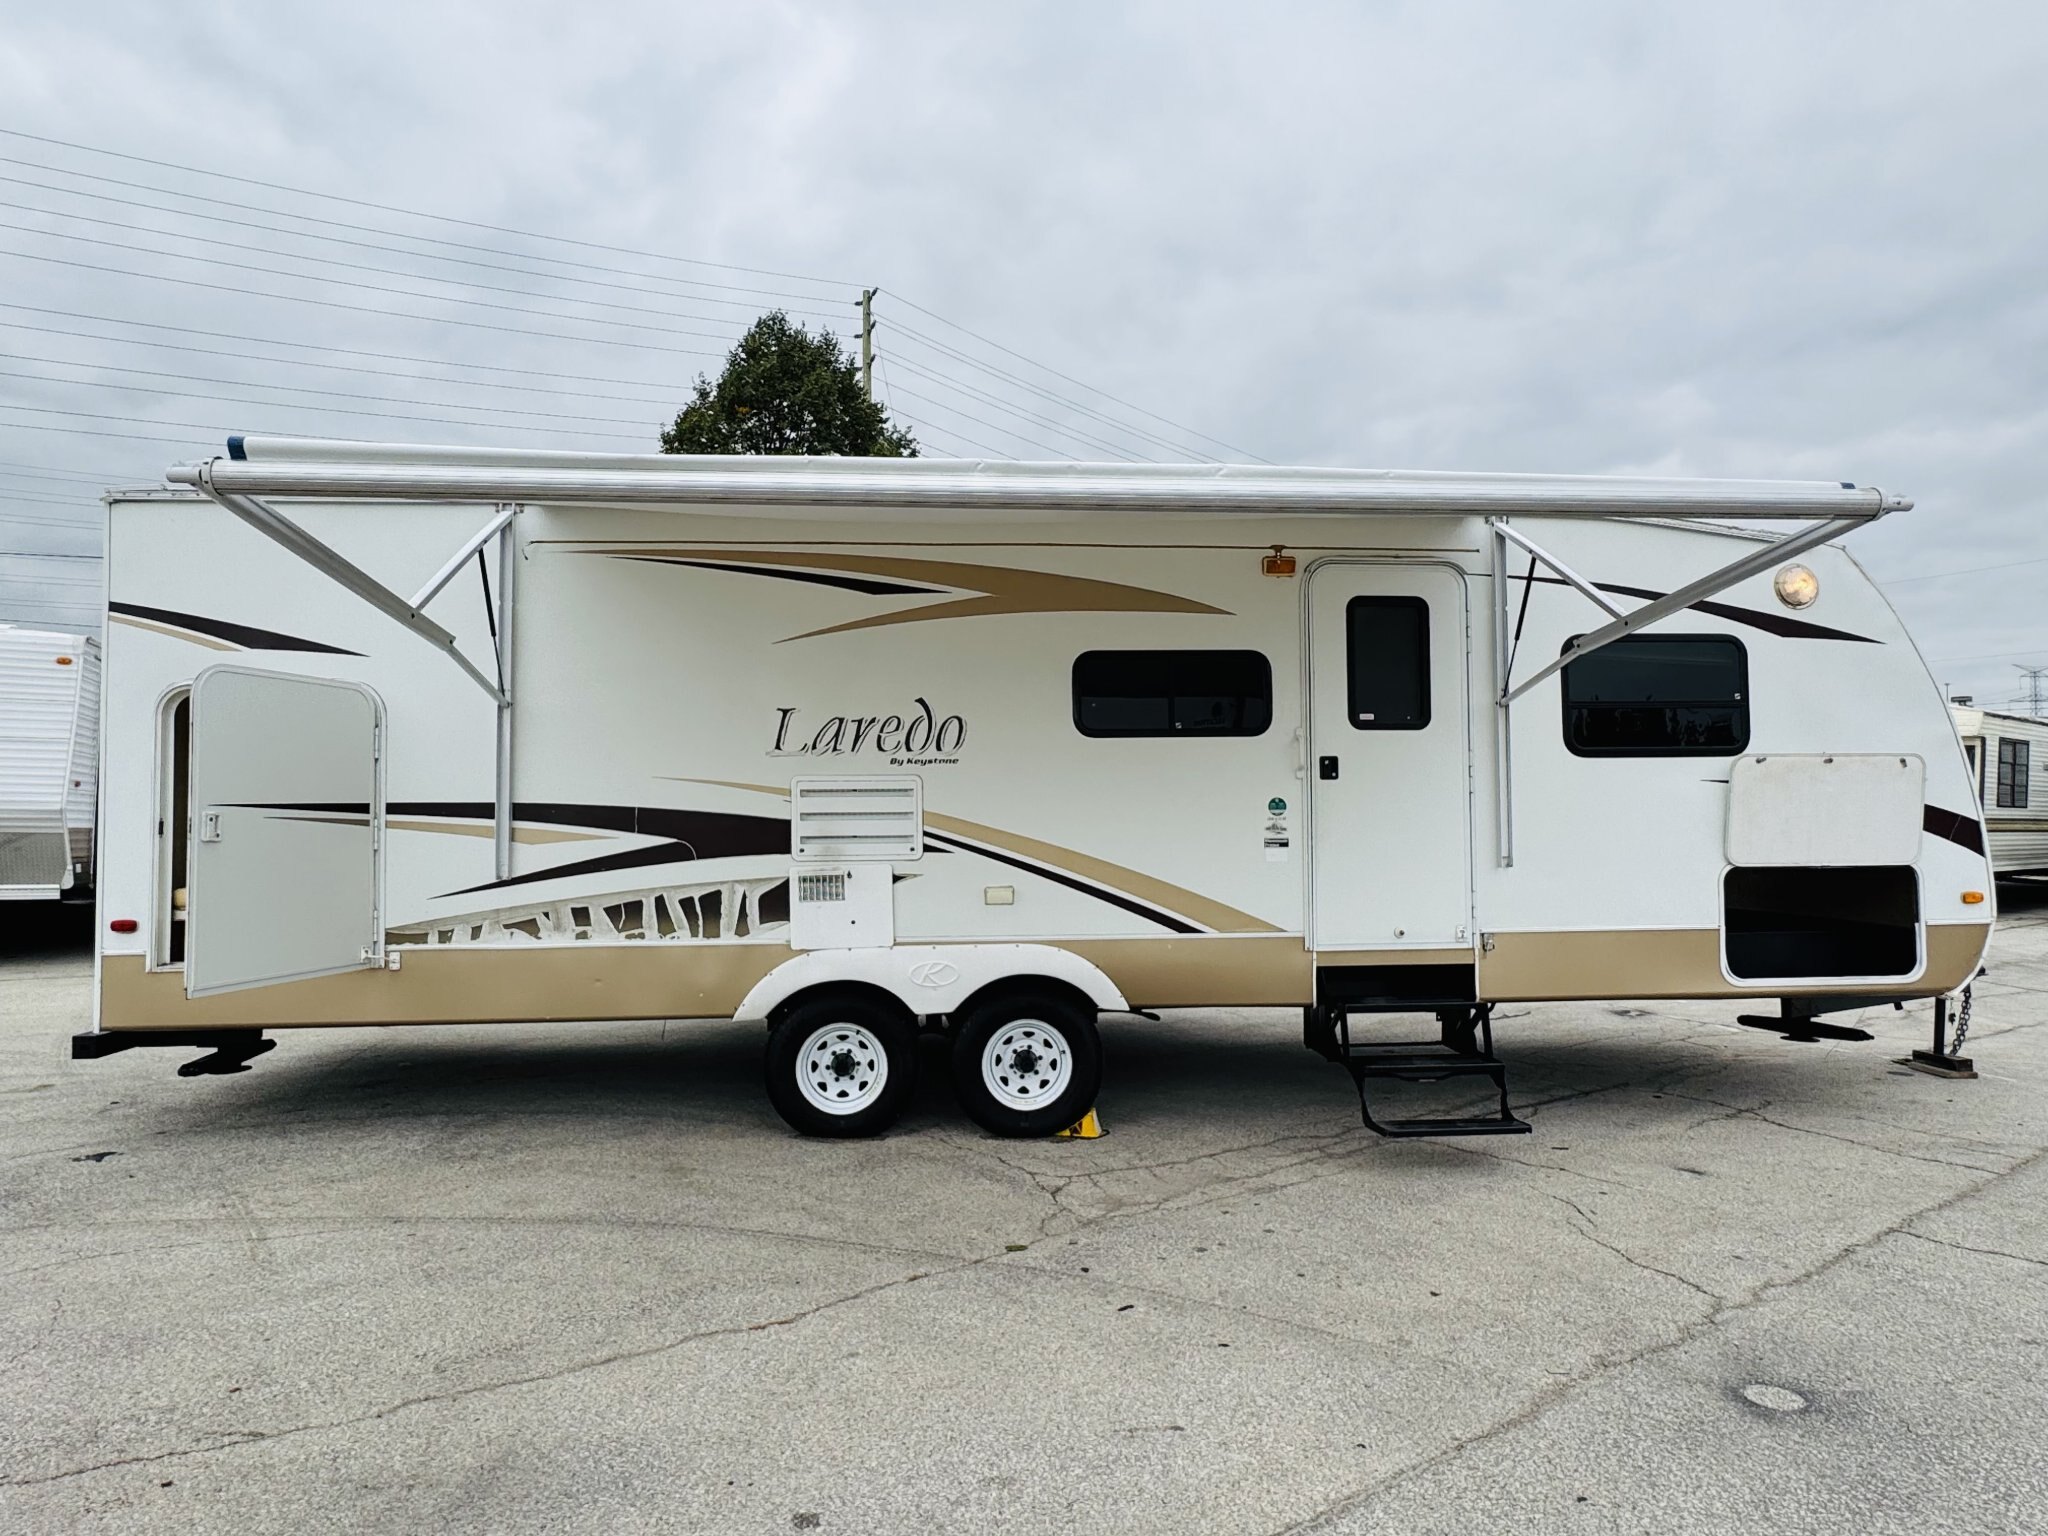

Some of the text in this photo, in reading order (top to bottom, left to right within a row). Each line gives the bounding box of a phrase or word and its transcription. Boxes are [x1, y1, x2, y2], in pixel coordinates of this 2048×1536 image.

[766, 696, 967, 757] Laredo
[890, 757, 960, 767] By Keystone
